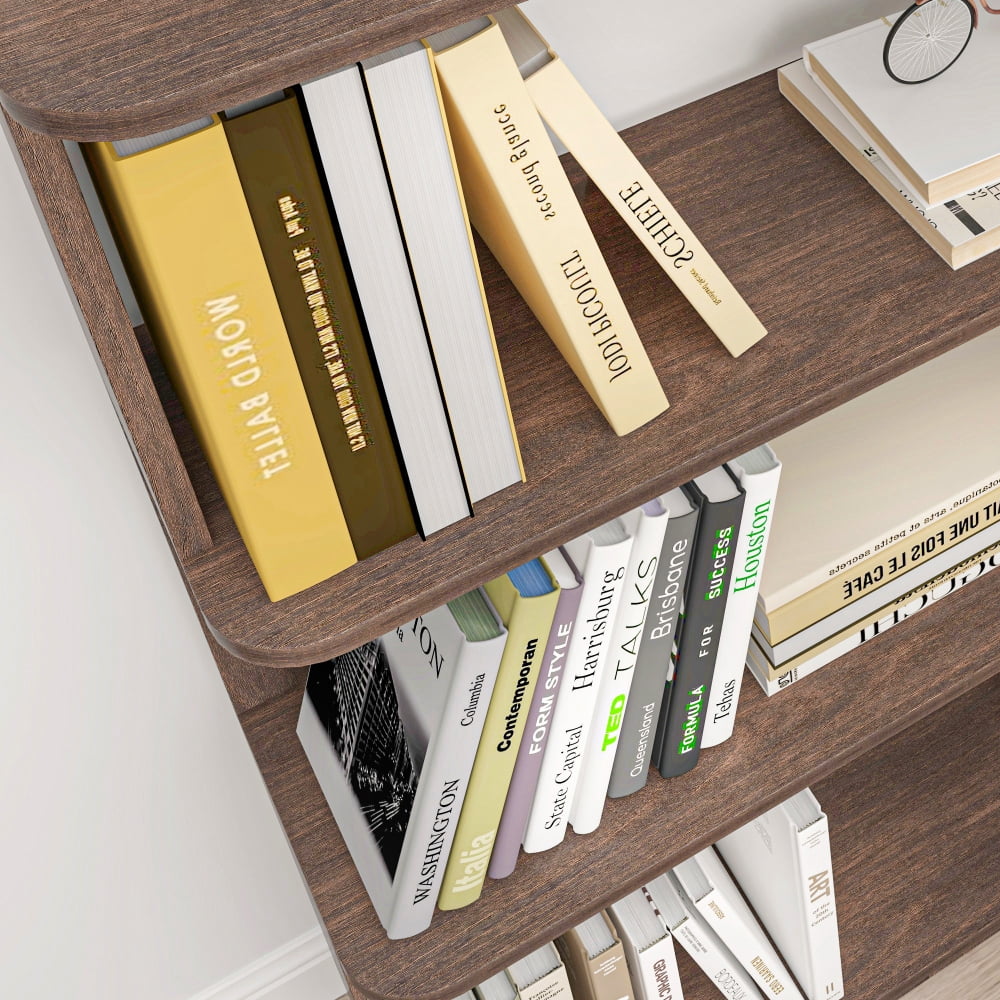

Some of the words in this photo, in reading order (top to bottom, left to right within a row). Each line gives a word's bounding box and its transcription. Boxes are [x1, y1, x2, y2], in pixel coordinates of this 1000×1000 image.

[705, 526, 733, 599] SUCCESS
[713, 680, 736, 724] Tehas
[734, 500, 770, 594] Houston
[529, 697, 554, 755] FORM
[545, 621, 572, 691] STYLE
[572, 566, 625, 693] Harrisburg
[601, 693, 626, 752] TED
[614, 556, 657, 680] TALKS
[630, 702, 655, 778] Queensland
[651, 538, 687, 640] Brisbane
[699, 625, 712, 657] FOR
[452, 831, 495, 894] Italia
[496, 638, 538, 753] Contemporan
[554, 724, 584, 788] Capital
[678, 684, 703, 755] FORMULA
[413, 779, 460, 905] WASHINGTON
[460, 672, 486, 728] Columbia
[545, 788, 568, 830] State
[808, 870, 831, 904] ART
